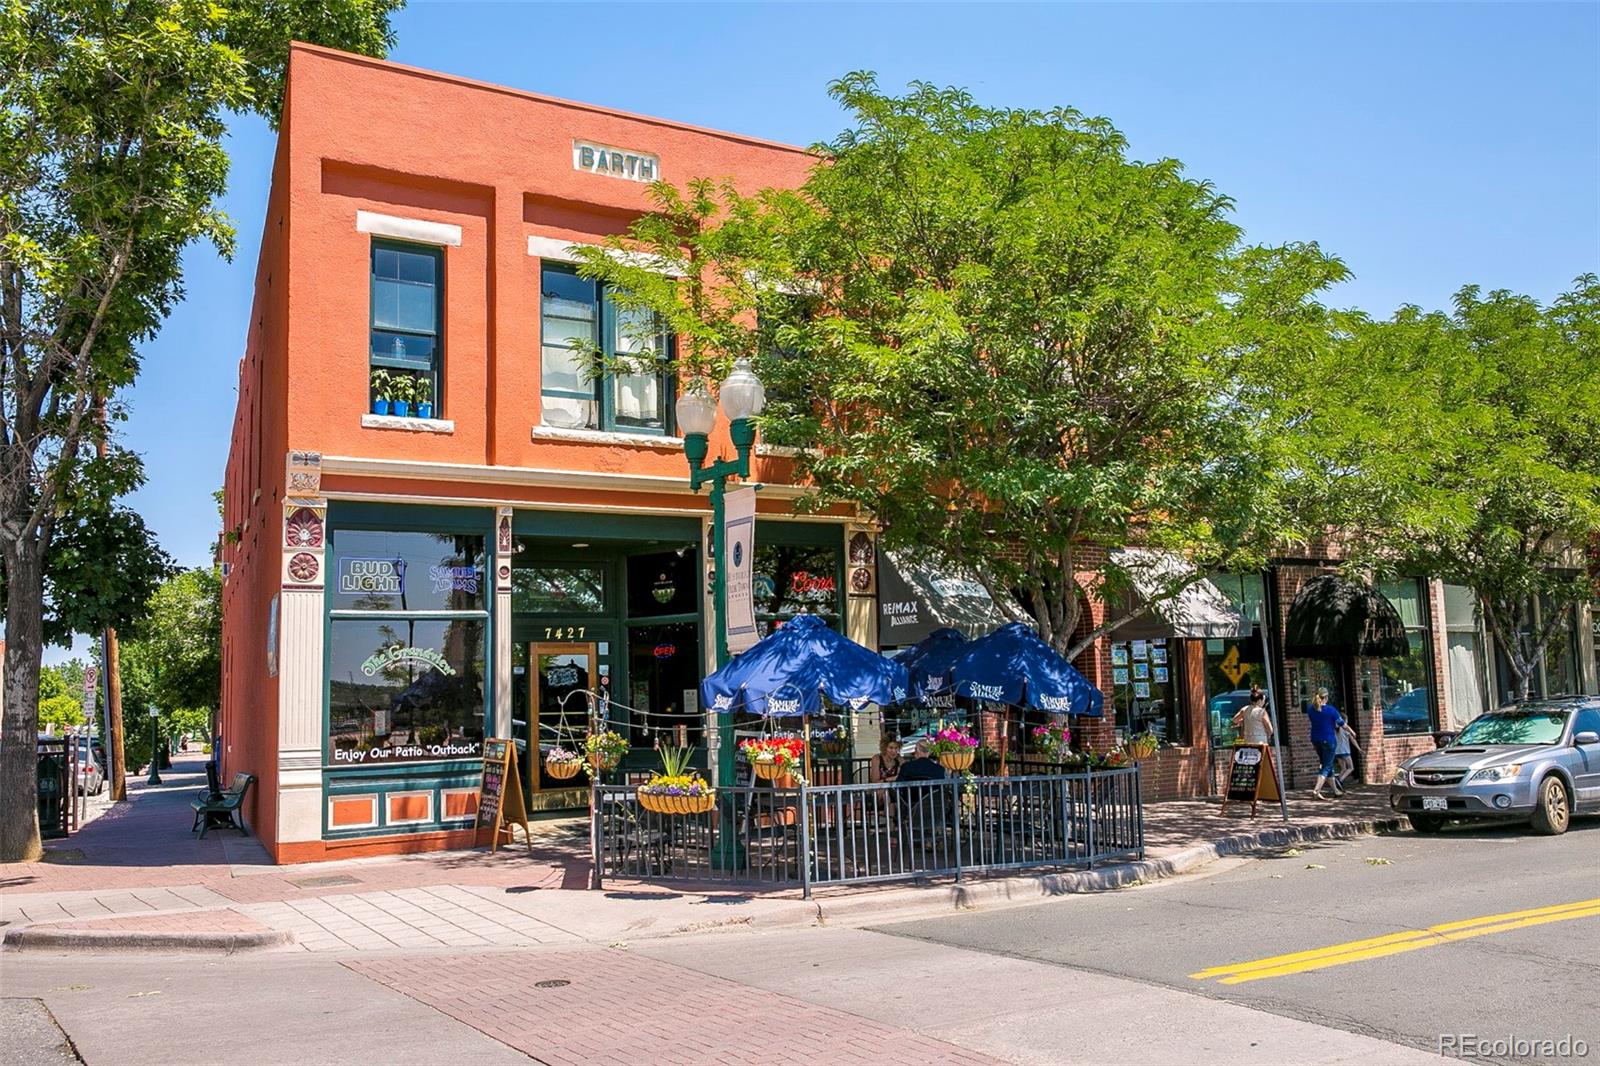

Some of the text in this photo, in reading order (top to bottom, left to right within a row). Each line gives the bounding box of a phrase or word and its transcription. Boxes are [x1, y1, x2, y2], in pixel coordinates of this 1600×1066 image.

[580, 146, 653, 179] BARTH
[351, 560, 393, 576] BUD
[429, 565, 480, 581] SAMUEL
[342, 575, 401, 591] LIGHT
[432, 578, 478, 595] ADAMS
[792, 571, 834, 593] Coors
[882, 600, 918, 615] RE/MAX
[891, 615, 919, 627] ALLIANCE
[545, 627, 586, 640] 7427
[653, 646, 676, 656] OPEN
[361, 645, 456, 676] The Grandview
[970, 681, 1004, 696] SAMUEL
[970, 689, 1000, 701] ADAMS
[767, 698, 801, 708] SAMUEL
[1040, 693, 1072, 704] SAMUEL
[1043, 700, 1072, 712] ADAMS
[769, 705, 798, 714] ADAMS
[334, 743, 480, 762] Enjoy Our Patio "Outback"
